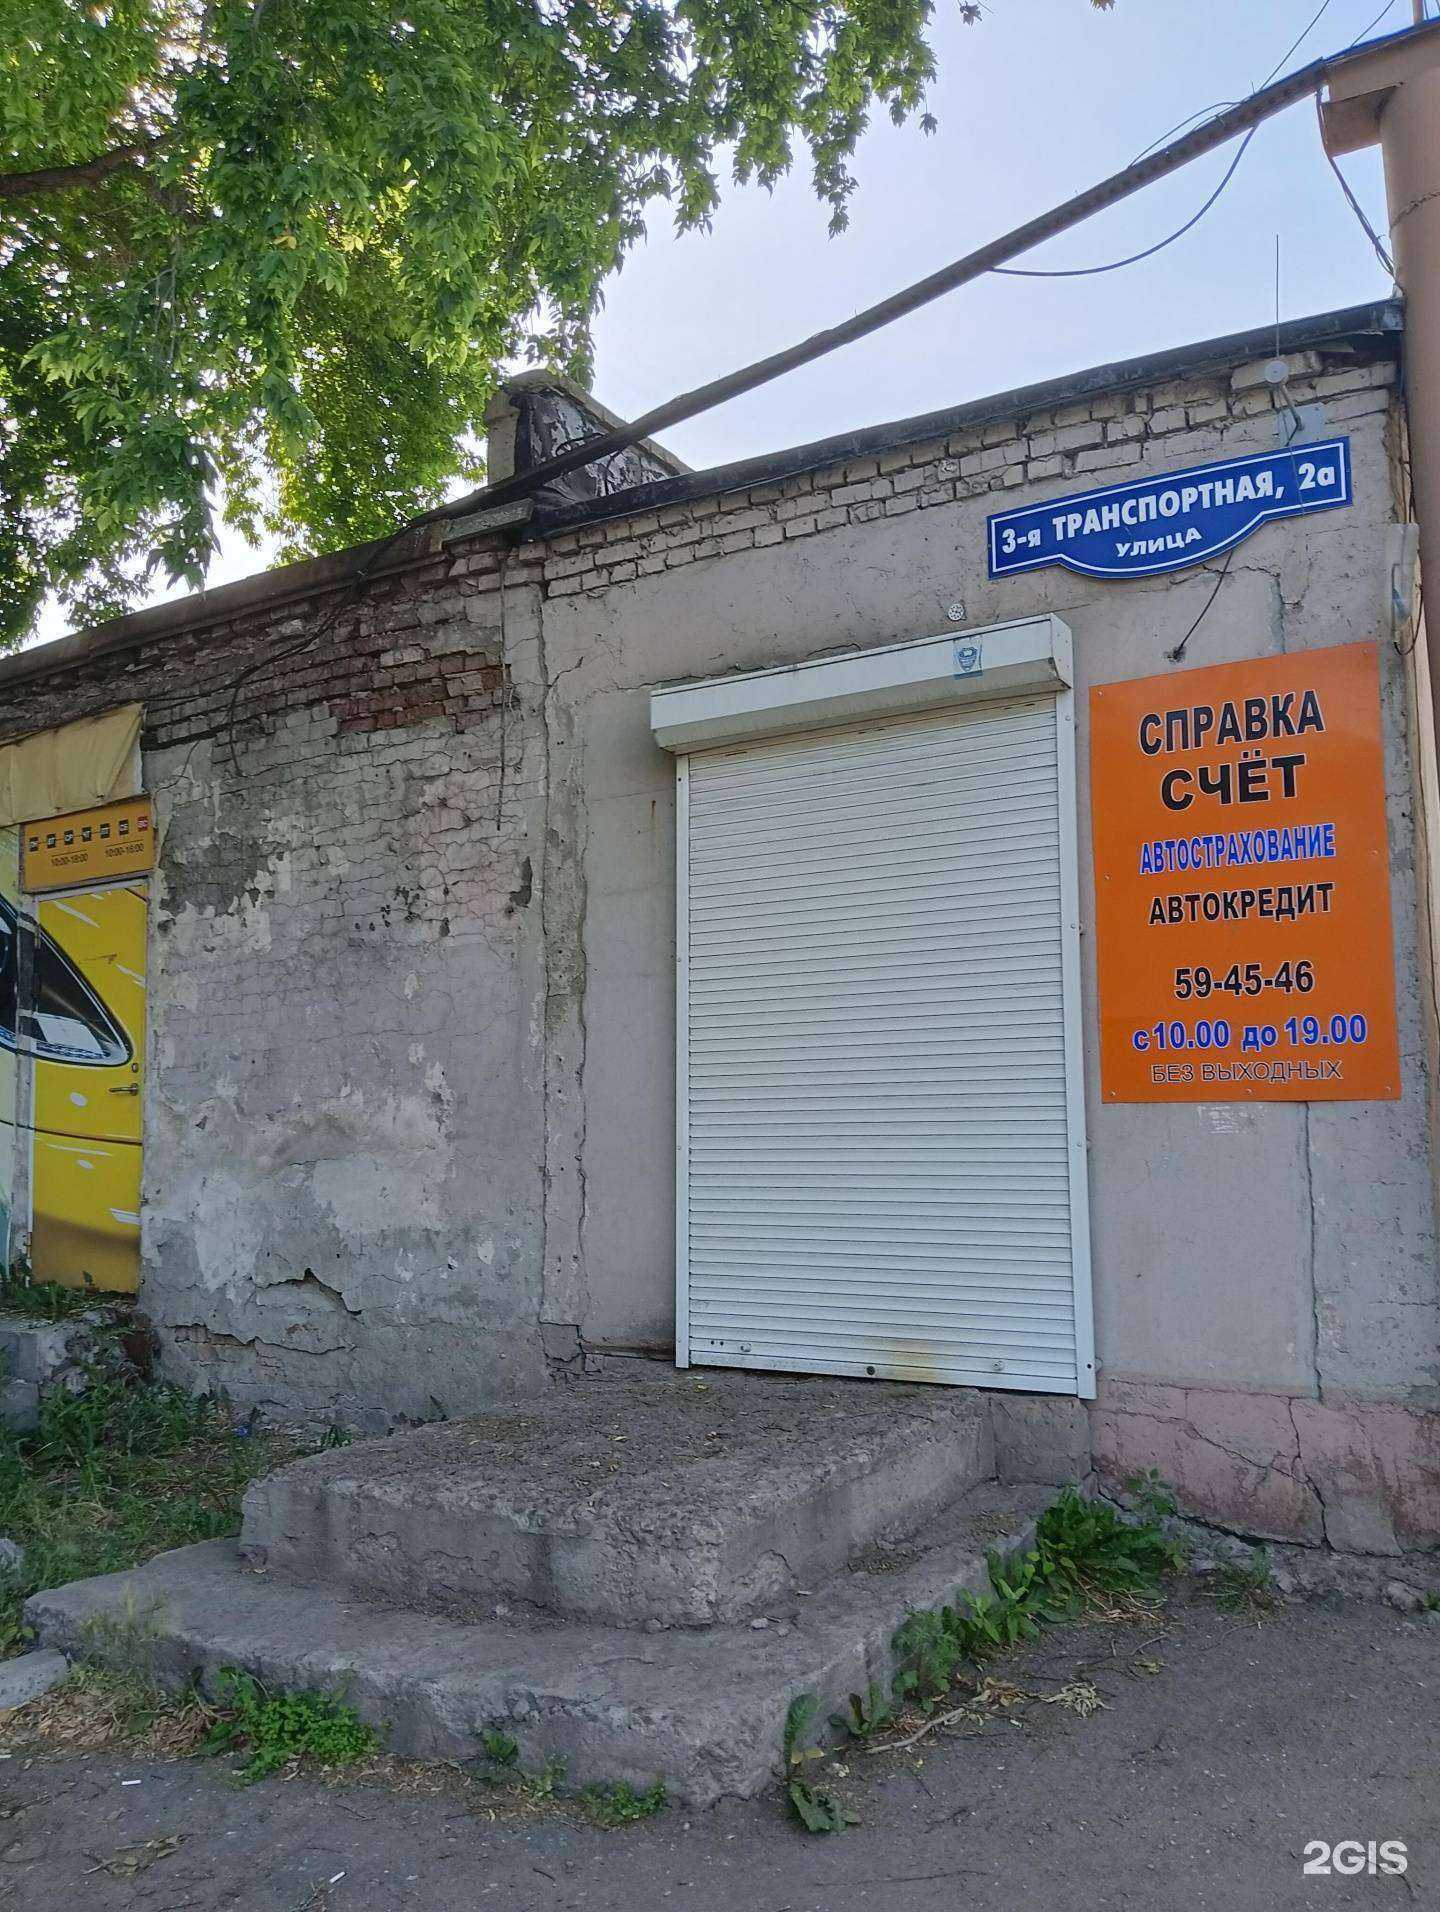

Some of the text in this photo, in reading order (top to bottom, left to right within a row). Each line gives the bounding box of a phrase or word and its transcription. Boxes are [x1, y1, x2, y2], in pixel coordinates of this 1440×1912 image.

[1002, 463, 1335, 553] 3-я ТРАНСПОРТНАЯ, 2а
[1115, 527, 1202, 558] УЛИЦА
[1138, 689, 1327, 756] СПРАВКА
[1160, 748, 1306, 812] СЧЁТ
[1139, 823, 1336, 875] АВТОСТРАХОВАНИЕ
[1148, 882, 1335, 925] АВТОКРЕДИТ
[1174, 960, 1314, 1000] 59-45-46
[1241, 1025, 1278, 1052] до
[1284, 1014, 1368, 1046] 19.00
[1151, 1060, 1344, 1083] БЕЗ ВЫХОДНЫХ
